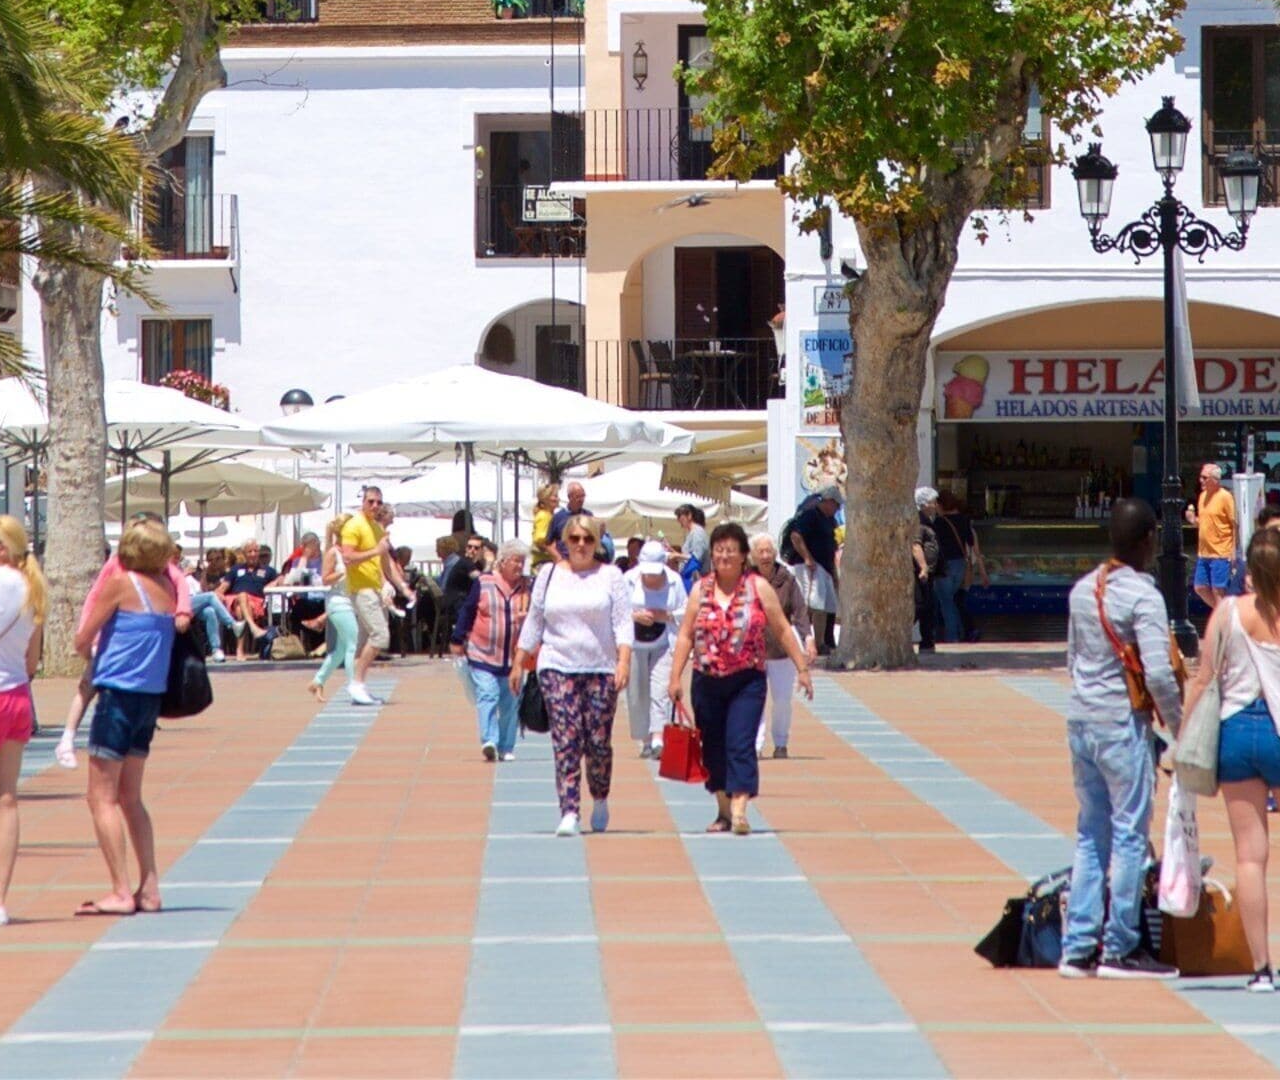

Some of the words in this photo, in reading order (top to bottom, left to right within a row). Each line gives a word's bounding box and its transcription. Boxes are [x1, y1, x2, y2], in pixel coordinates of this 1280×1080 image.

[805, 338, 850, 352] EDIFICIO
[995, 399, 1078, 417] HELADOS
[1083, 399, 1187, 417] ARTESANS
[1202, 399, 1255, 417] HOME
